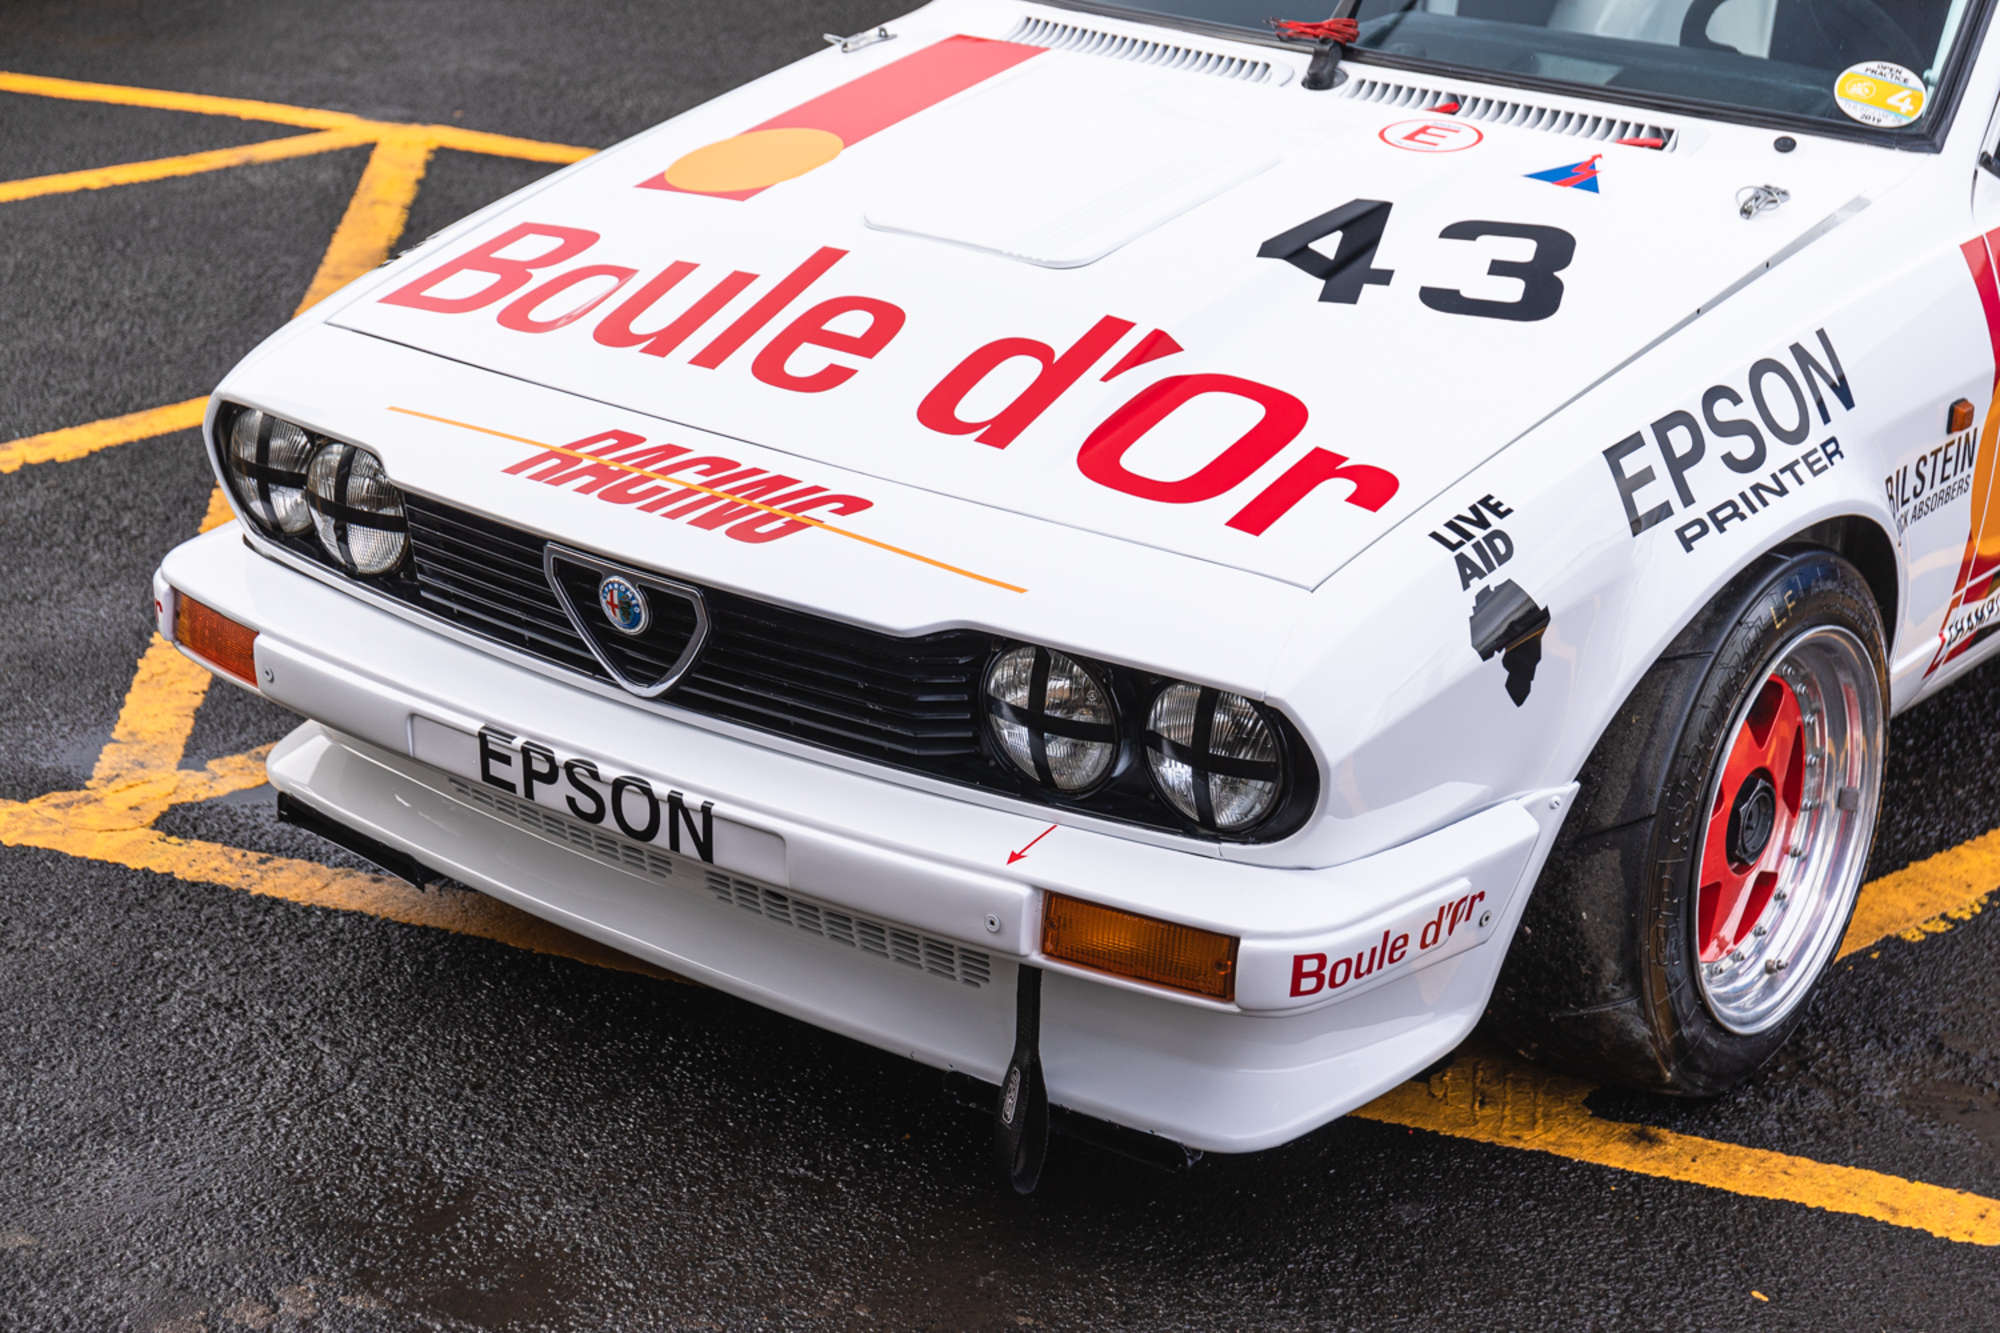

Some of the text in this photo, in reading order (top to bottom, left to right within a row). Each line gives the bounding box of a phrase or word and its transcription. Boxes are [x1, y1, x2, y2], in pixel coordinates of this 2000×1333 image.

[1401, 125, 1461, 147] E
[1886, 90, 1914, 113] 4
[1256, 198, 1577, 322] 43
[376, 221, 1400, 537] Boule d'Or
[1602, 327, 1856, 538] EPSON
[501, 429, 874, 544] RACING
[1428, 494, 1514, 552] LIVE
[1674, 436, 1845, 554] PRINTER
[1884, 427, 1978, 520] BILSTEIN
[1910, 474, 1971, 525] ABSORBERS
[1454, 529, 1514, 591] AID
[478, 725, 715, 864] EPSON
[1289, 890, 1485, 998] Boule d'Or
